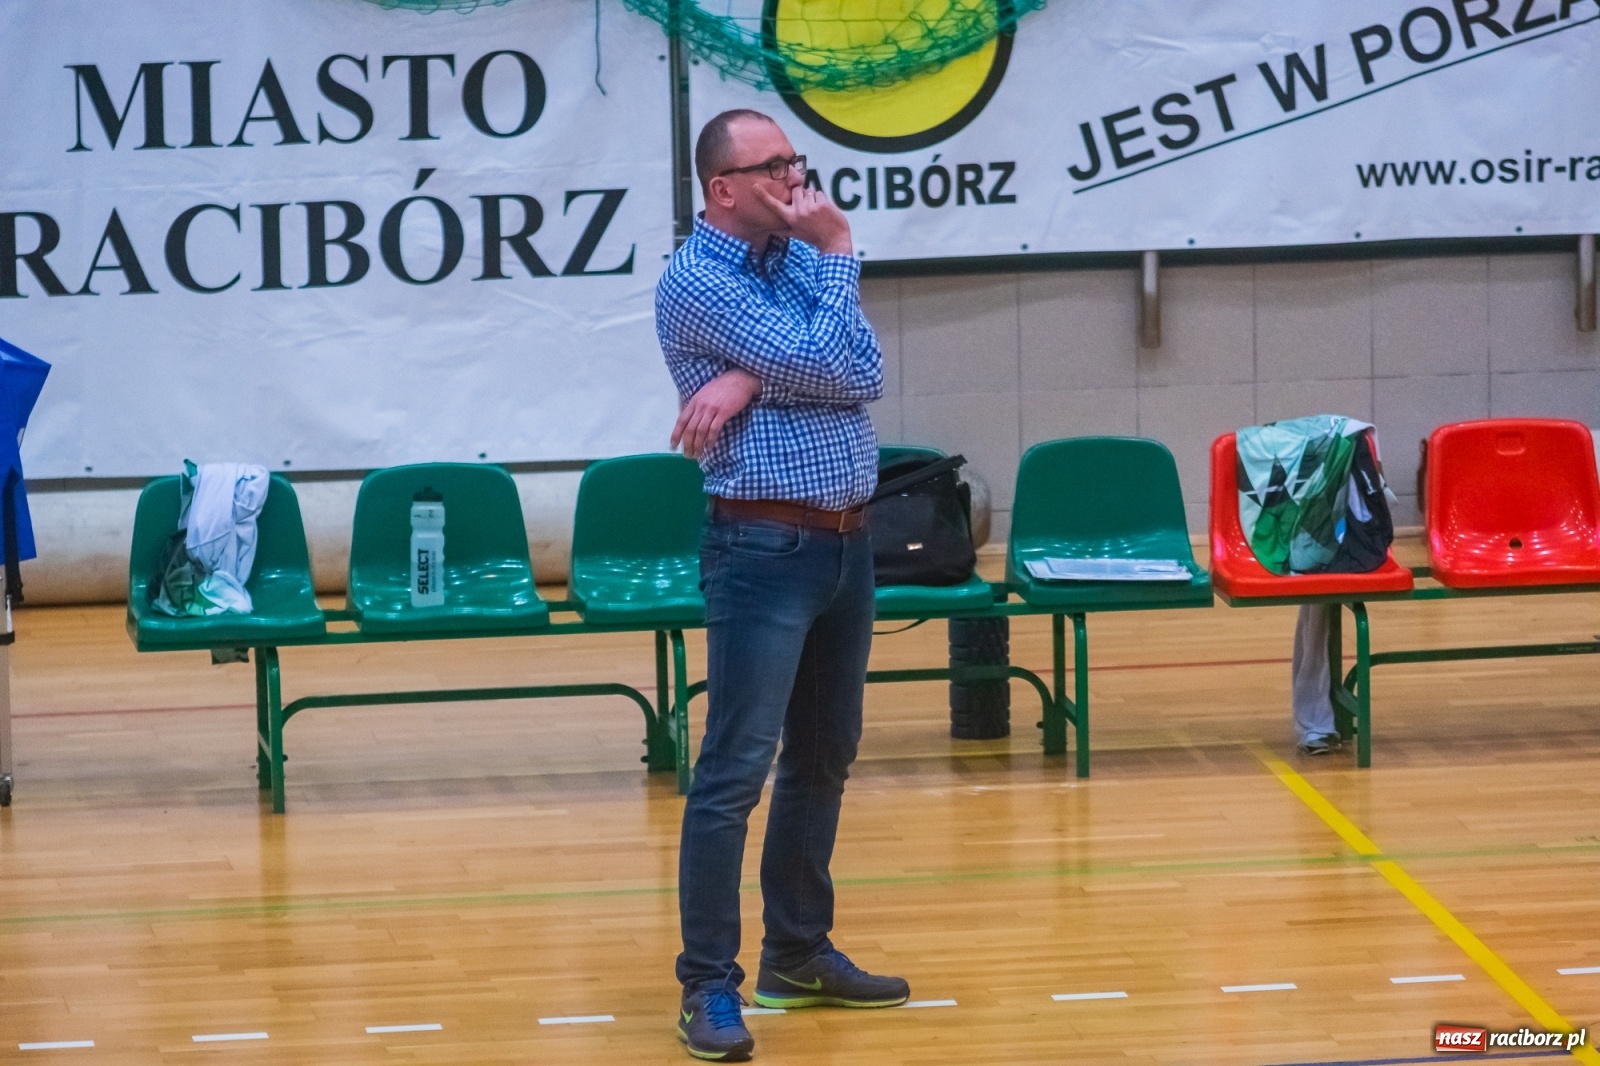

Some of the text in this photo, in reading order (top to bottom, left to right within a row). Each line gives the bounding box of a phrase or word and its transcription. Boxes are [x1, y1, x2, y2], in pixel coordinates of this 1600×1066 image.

[64, 50, 547, 152] MIASTO
[1067, 73, 1239, 181] JEST
[1257, 43, 1331, 114] W
[0, 168, 637, 299] RACIBÓRZ
[803, 154, 1017, 212] ACIBÓRZ
[417, 548, 429, 595] SELECT
